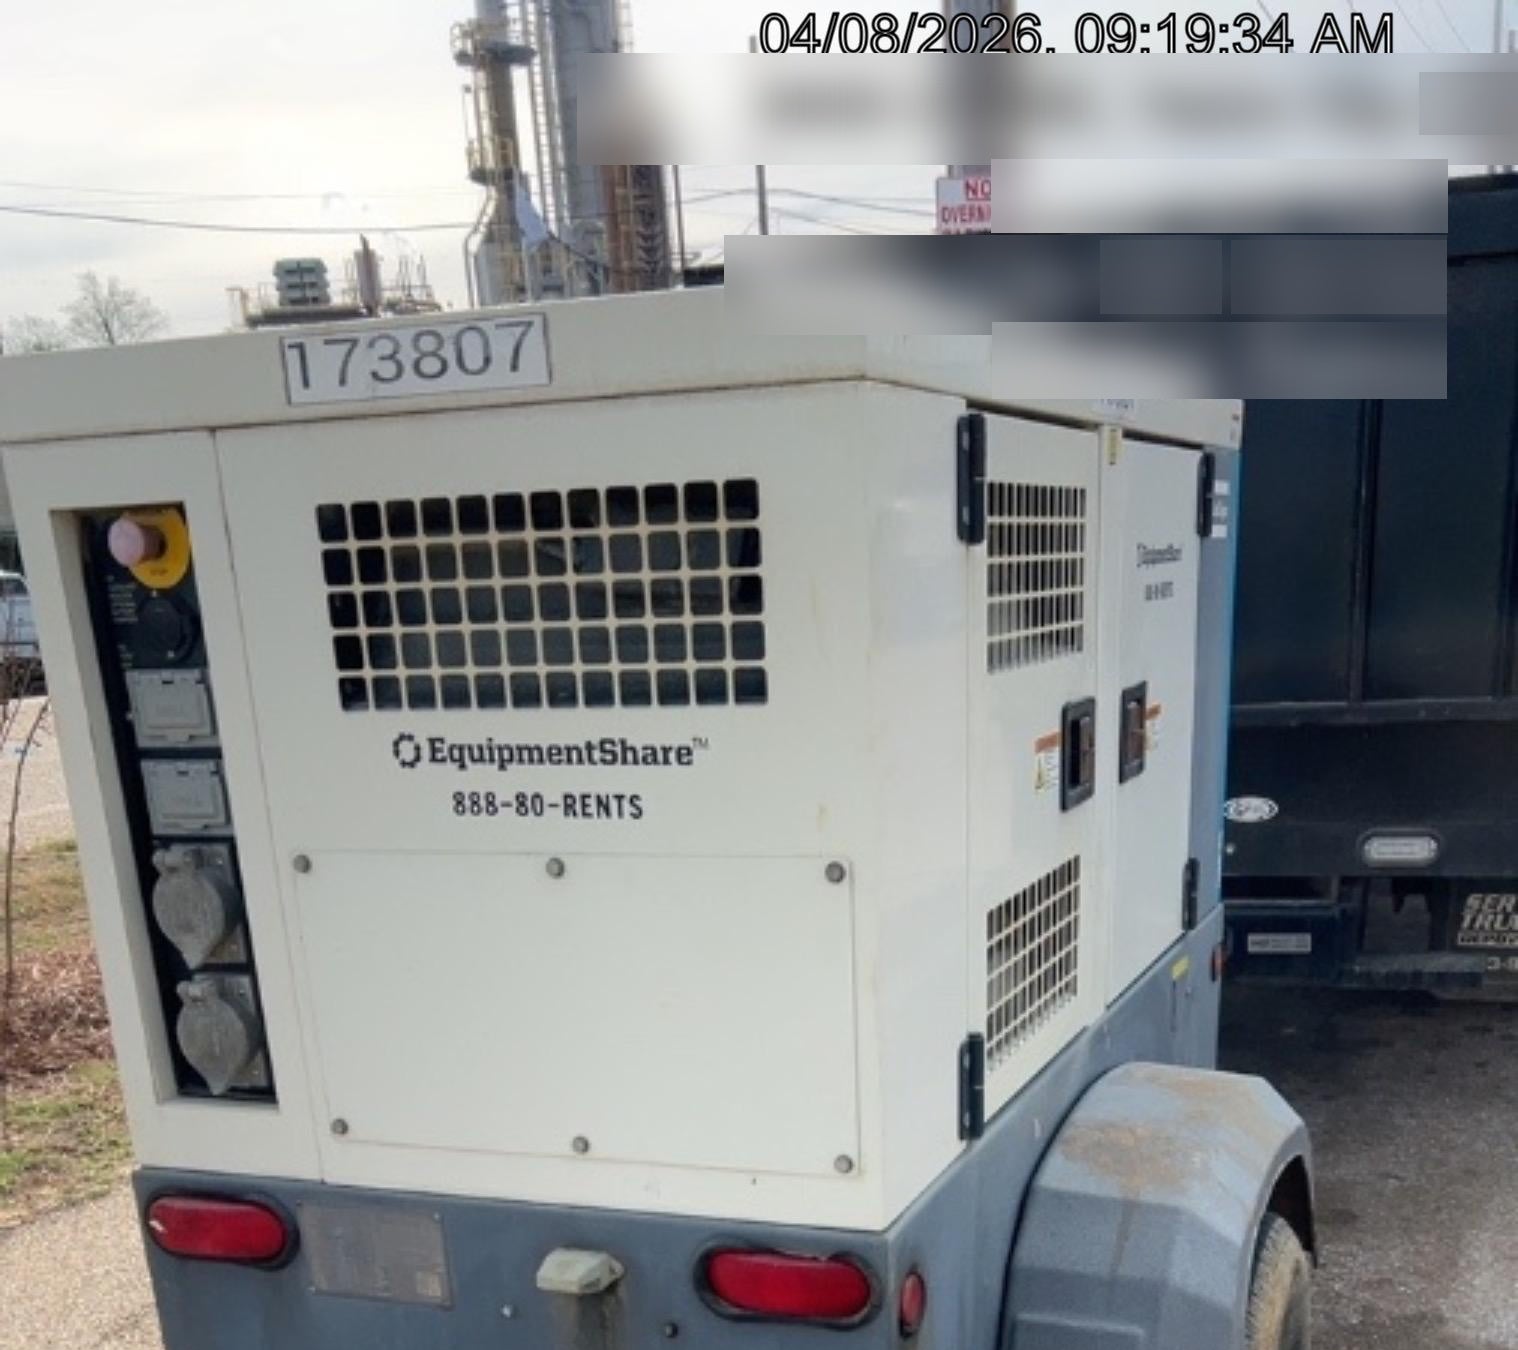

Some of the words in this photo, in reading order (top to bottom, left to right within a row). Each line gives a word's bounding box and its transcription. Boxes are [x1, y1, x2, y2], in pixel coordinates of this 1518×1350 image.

[965, 178, 991, 196] NO
[287, 320, 535, 390] 173807
[452, 791, 644, 819] 888-80-RENTS
